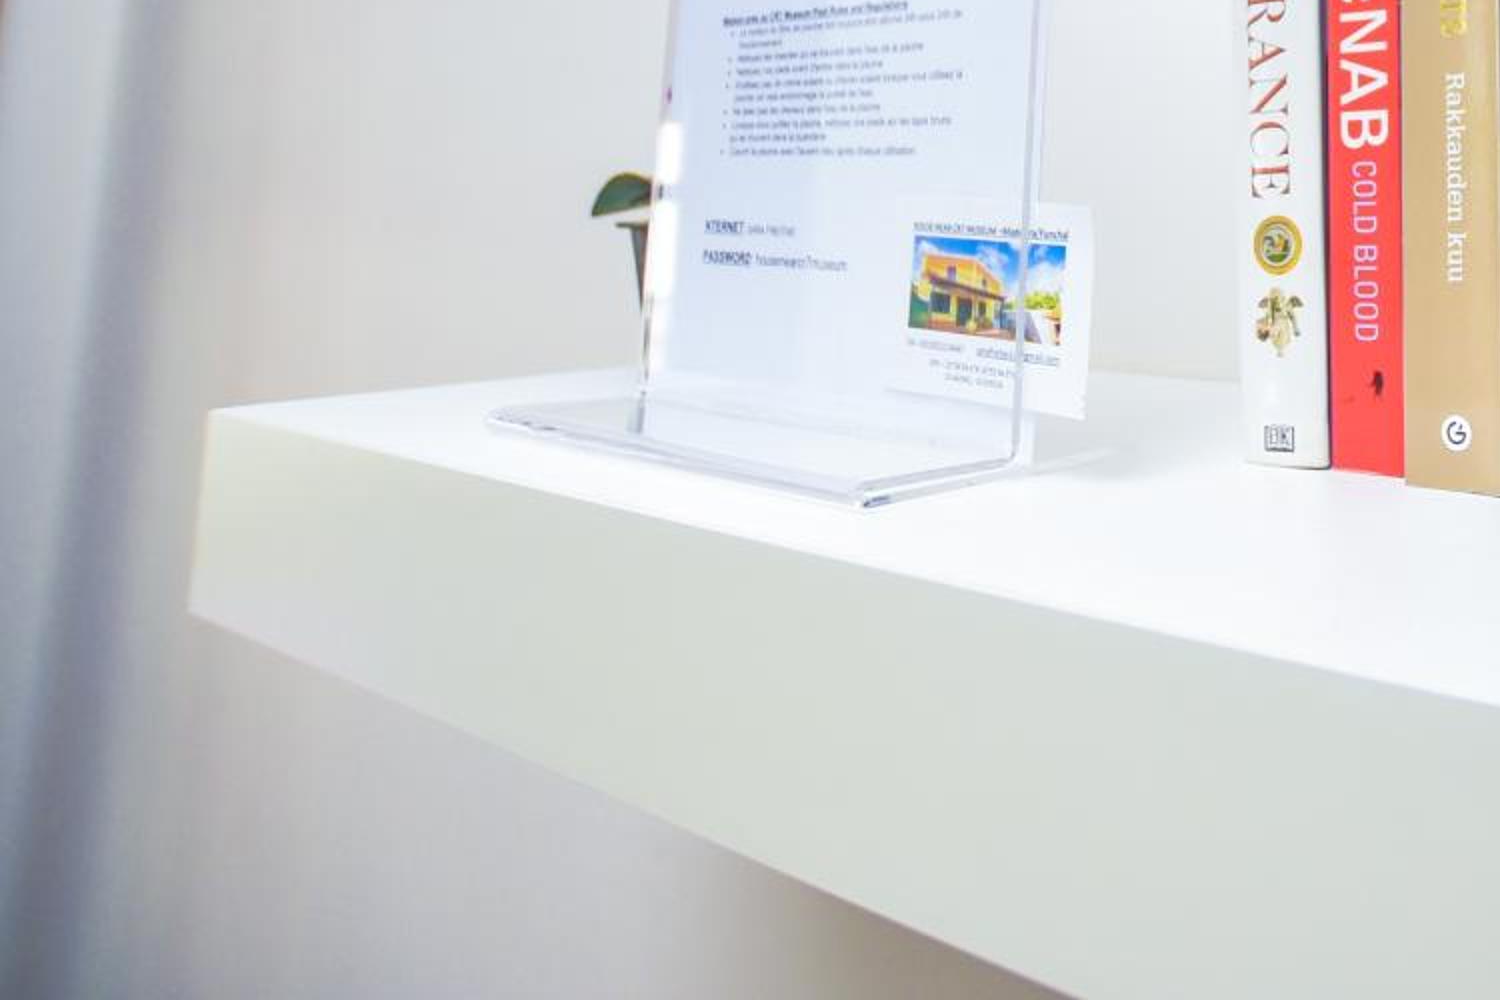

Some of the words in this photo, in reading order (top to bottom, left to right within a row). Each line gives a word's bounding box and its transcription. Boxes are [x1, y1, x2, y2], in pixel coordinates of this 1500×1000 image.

[1445, 73, 1468, 223] Rakkauden
[1352, 161, 1378, 234] COLD
[1354, 245, 1380, 343] BLOOD
[1447, 230, 1468, 284] kuu
